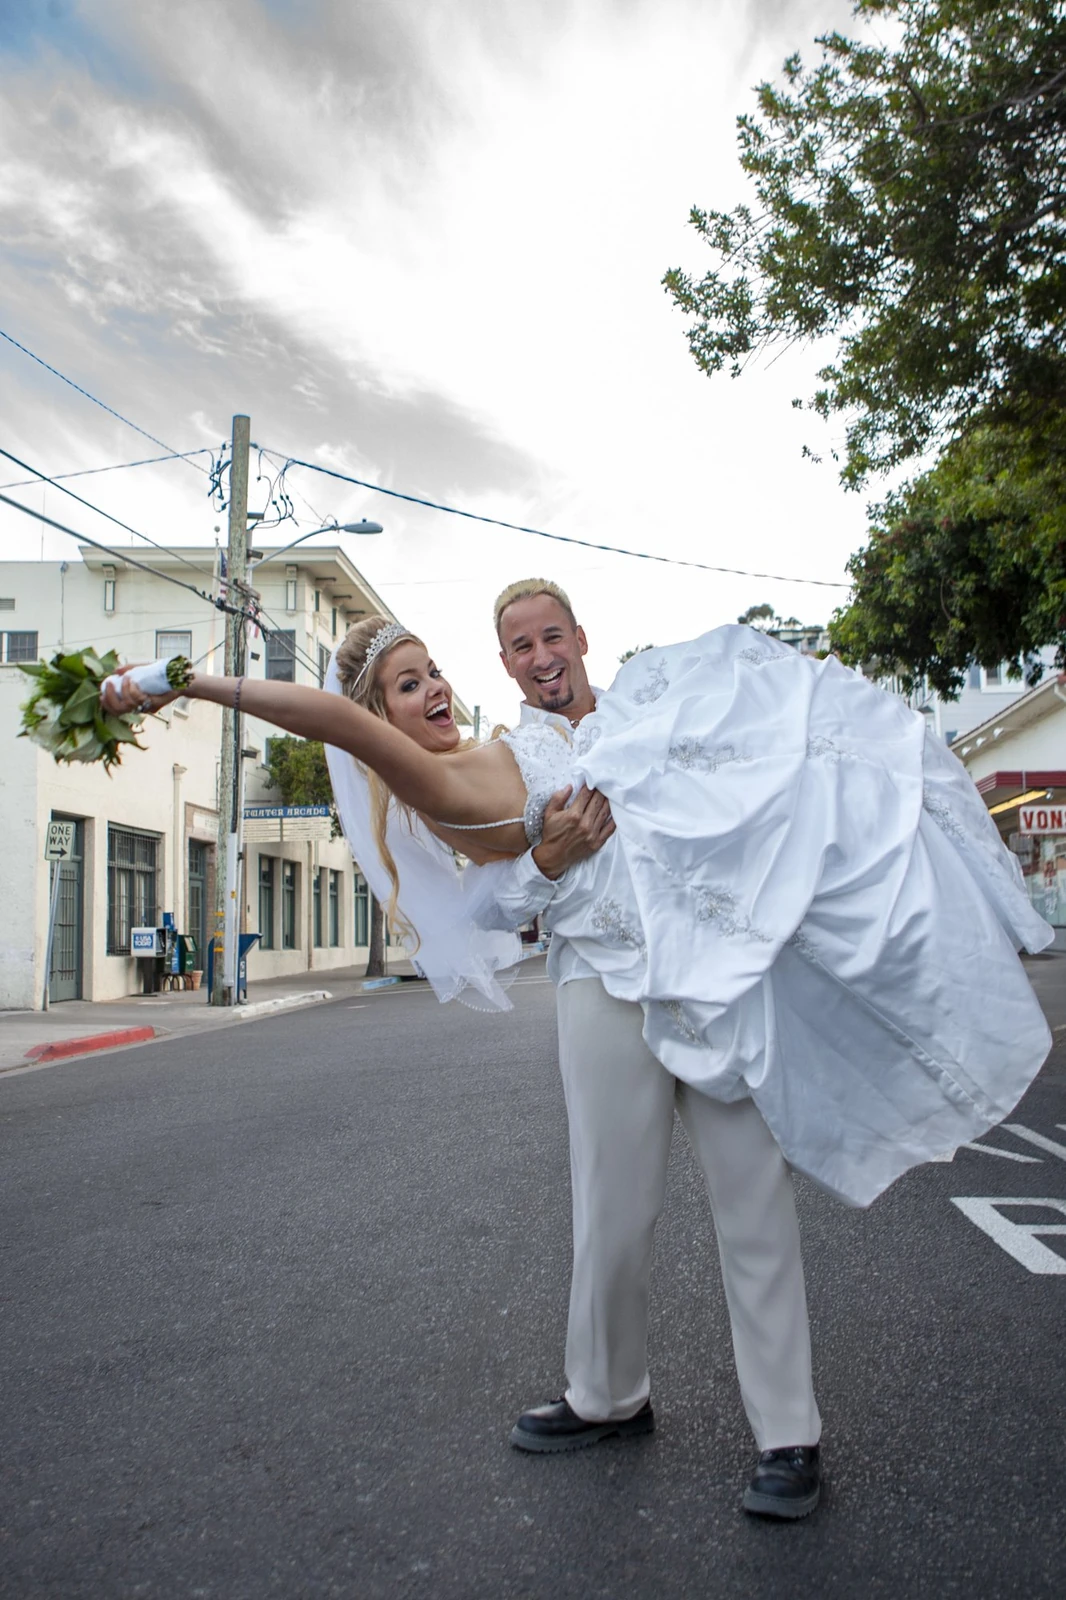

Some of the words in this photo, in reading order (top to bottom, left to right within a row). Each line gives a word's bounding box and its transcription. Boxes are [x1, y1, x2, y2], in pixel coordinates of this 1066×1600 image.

[244, 808, 284, 818] TWATER
[286, 807, 327, 817] ARCADE
[1022, 810, 1066, 829] VON
[51, 825, 71, 836] ONE
[50, 836, 71, 846] WAY
